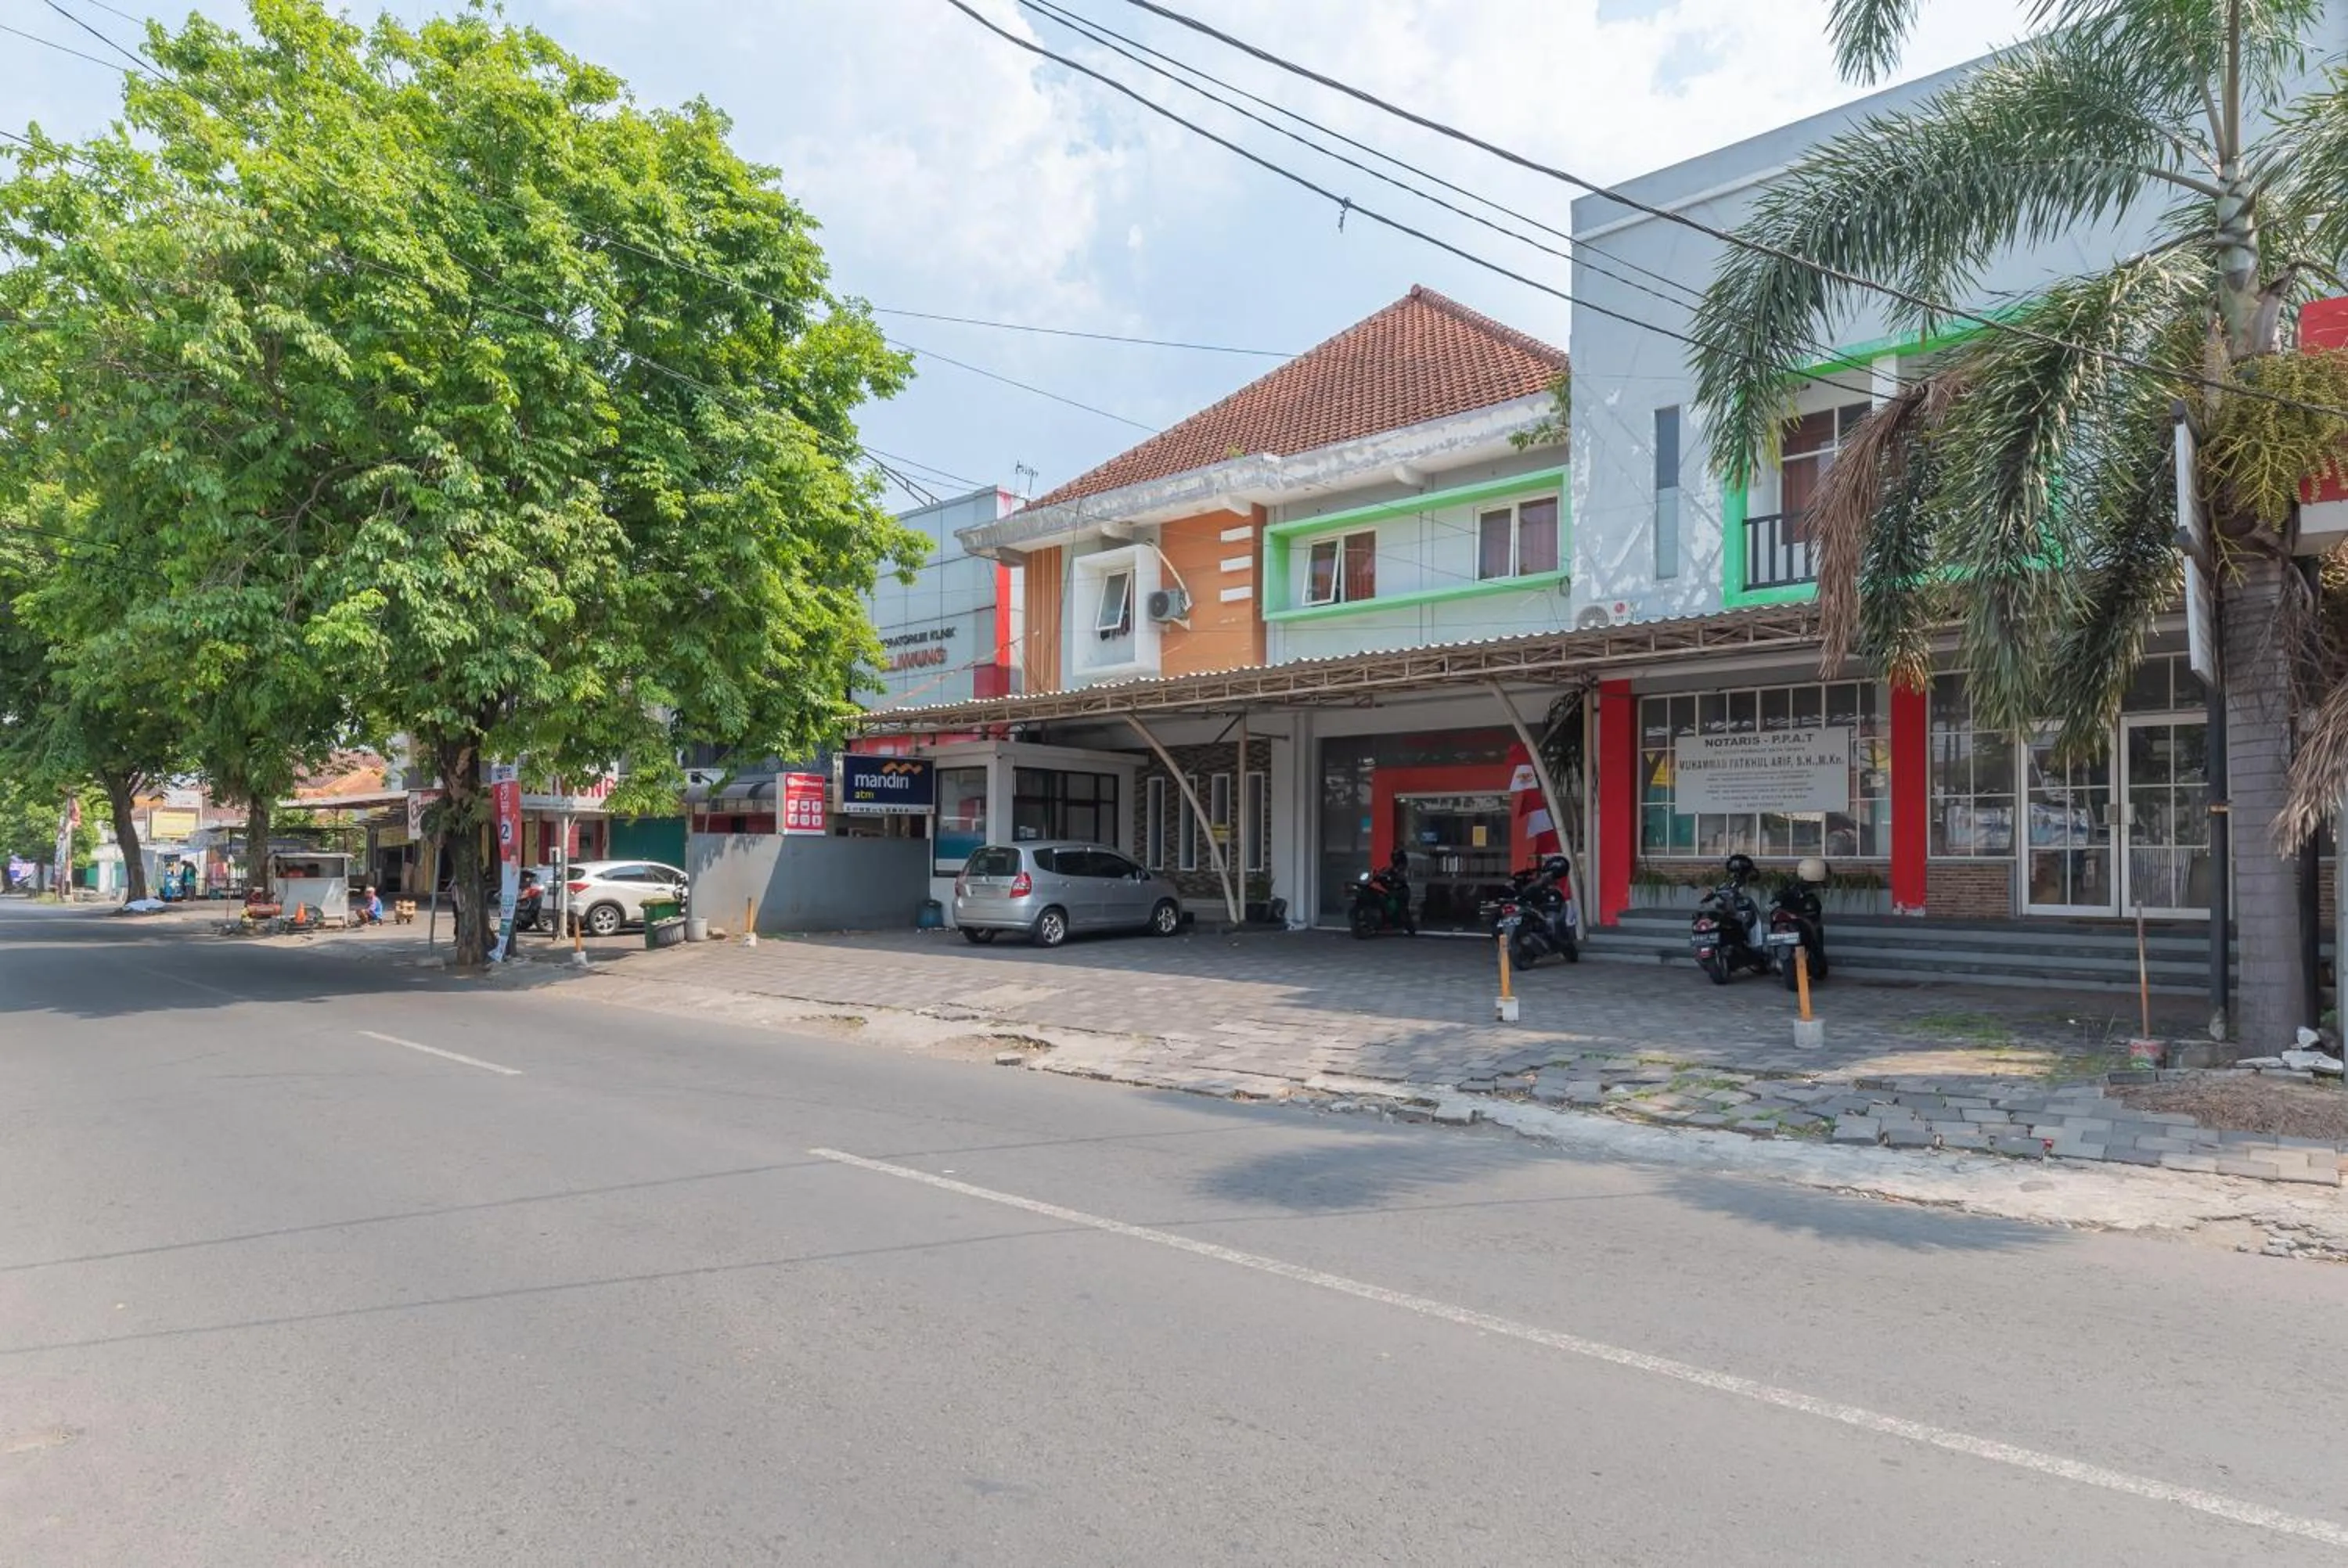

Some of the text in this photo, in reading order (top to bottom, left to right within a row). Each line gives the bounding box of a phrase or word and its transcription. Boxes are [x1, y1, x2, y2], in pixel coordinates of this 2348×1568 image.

[1705, 736, 1760, 748] NOTARIS
[854, 771, 909, 789] mandiri
[854, 790, 875, 799] atm
[501, 824, 510, 840] 2
